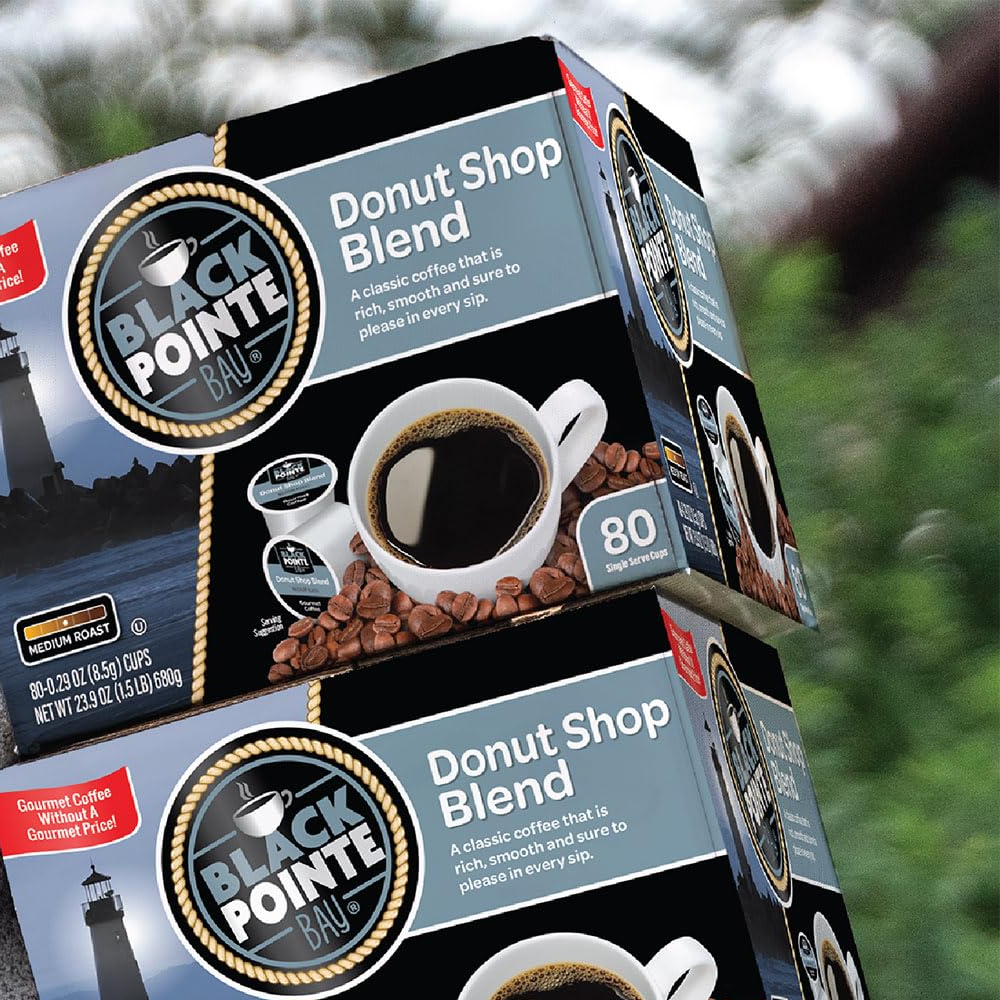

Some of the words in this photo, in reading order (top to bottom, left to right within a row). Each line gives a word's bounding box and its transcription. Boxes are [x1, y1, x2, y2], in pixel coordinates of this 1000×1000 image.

[329, 163, 456, 230] Donut
[459, 137, 563, 192] Shop
[339, 199, 471, 273] Blend
[105, 230, 269, 358] BLACK
[351, 289, 361, 302] A
[363, 275, 409, 298] classic
[412, 261, 456, 283] coffee
[458, 251, 489, 269] that
[490, 247, 503, 260] is
[354, 301, 386, 321] rich,
[388, 284, 442, 312] smooth
[443, 276, 470, 295] and
[472, 267, 504, 286] sure
[505, 262, 521, 277] to
[125, 268, 289, 397] POINTE
[359, 317, 405, 342] please
[407, 309, 420, 325] in
[422, 301, 461, 321] every
[463, 291, 489, 310] sip.
[600, 508, 657, 556] 80
[605, 559, 629, 573] Single
[629, 555, 650, 567] Serve
[650, 548, 669, 562] Cups
[28, 634, 72, 656] MEDIUM
[74, 622, 110, 643] ROAST
[29, 672, 72, 700] 80-0.29
[71, 668, 87, 688] OZ
[87, 656, 122, 685] (8.5g)
[123, 648, 152, 672] CUPS
[34, 702, 55, 725] NET
[55, 697, 73, 719] WT
[74, 690, 99, 713] 23.9
[99, 684, 113, 706] OZ
[114, 678, 134, 704] (1.5
[134, 672, 153, 695] LB)
[154, 668, 183, 689] 680g
[426, 724, 558, 786] Donut
[562, 699, 671, 751] Shop
[17, 795, 71, 813] Gourmet
[72, 787, 111, 807] Coffee
[38, 808, 88, 825] Without
[90, 806, 99, 819] A
[438, 758, 575, 828] Blend
[27, 825, 80, 841] Gourmet
[83, 815, 117, 835] Price!
[200, 784, 365, 905] BLACK
[450, 844, 461, 857] A
[463, 831, 511, 853] classic
[513, 818, 560, 839] coffee
[562, 809, 593, 826] that
[595, 805, 608, 818] is
[455, 854, 487, 875] rich,
[489, 841, 545, 866] smooth
[547, 832, 574, 850] and
[576, 825, 609, 843] sure
[611, 820, 627, 833] to
[221, 822, 386, 944] POINTE
[459, 870, 507, 895] please
[508, 864, 523, 879] in
[525, 856, 565, 876] every
[567, 848, 594, 866] sip.
